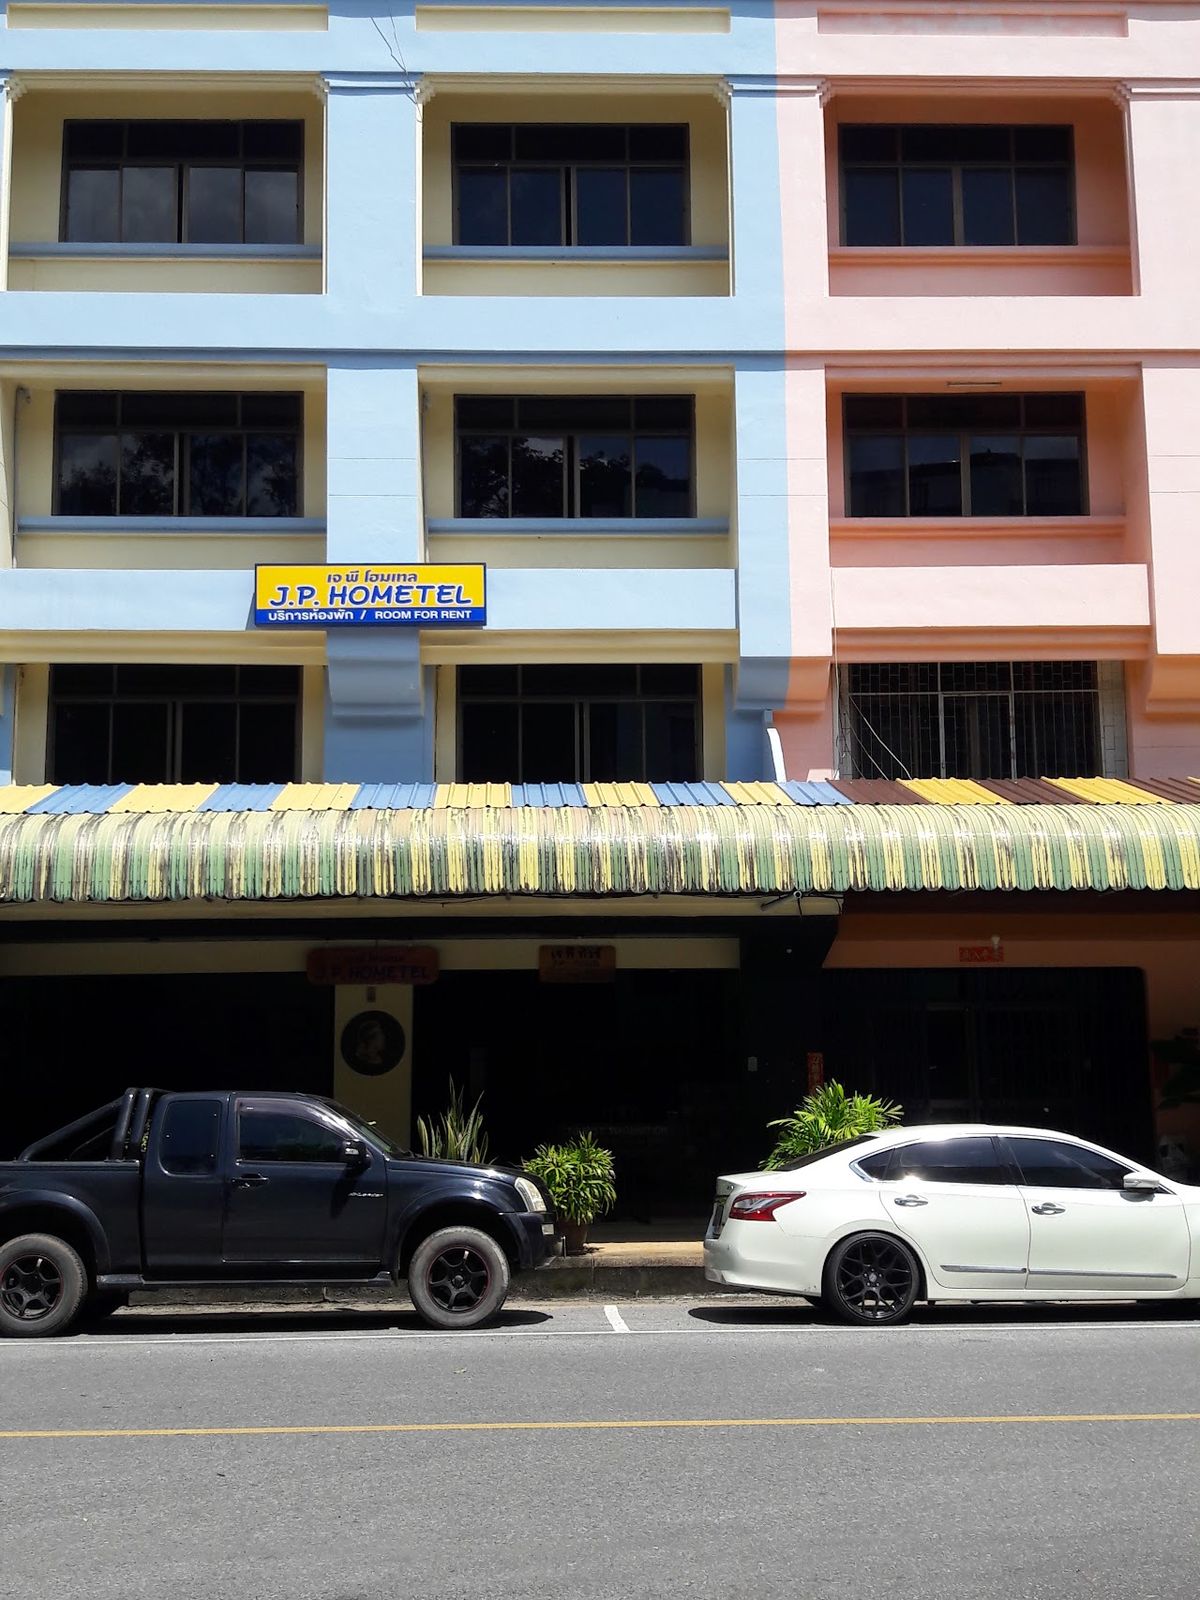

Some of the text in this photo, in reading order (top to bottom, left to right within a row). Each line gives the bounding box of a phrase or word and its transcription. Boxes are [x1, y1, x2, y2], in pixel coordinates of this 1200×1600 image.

[327, 570, 418, 583] เจ พี โฮมเทล
[270, 585, 472, 606] J.P. HOMETEL
[268, 609, 353, 621] บริการห้องพัก
[375, 611, 411, 620] ROOM
[414, 610, 441, 620] FOR
[444, 610, 472, 619] RENT
